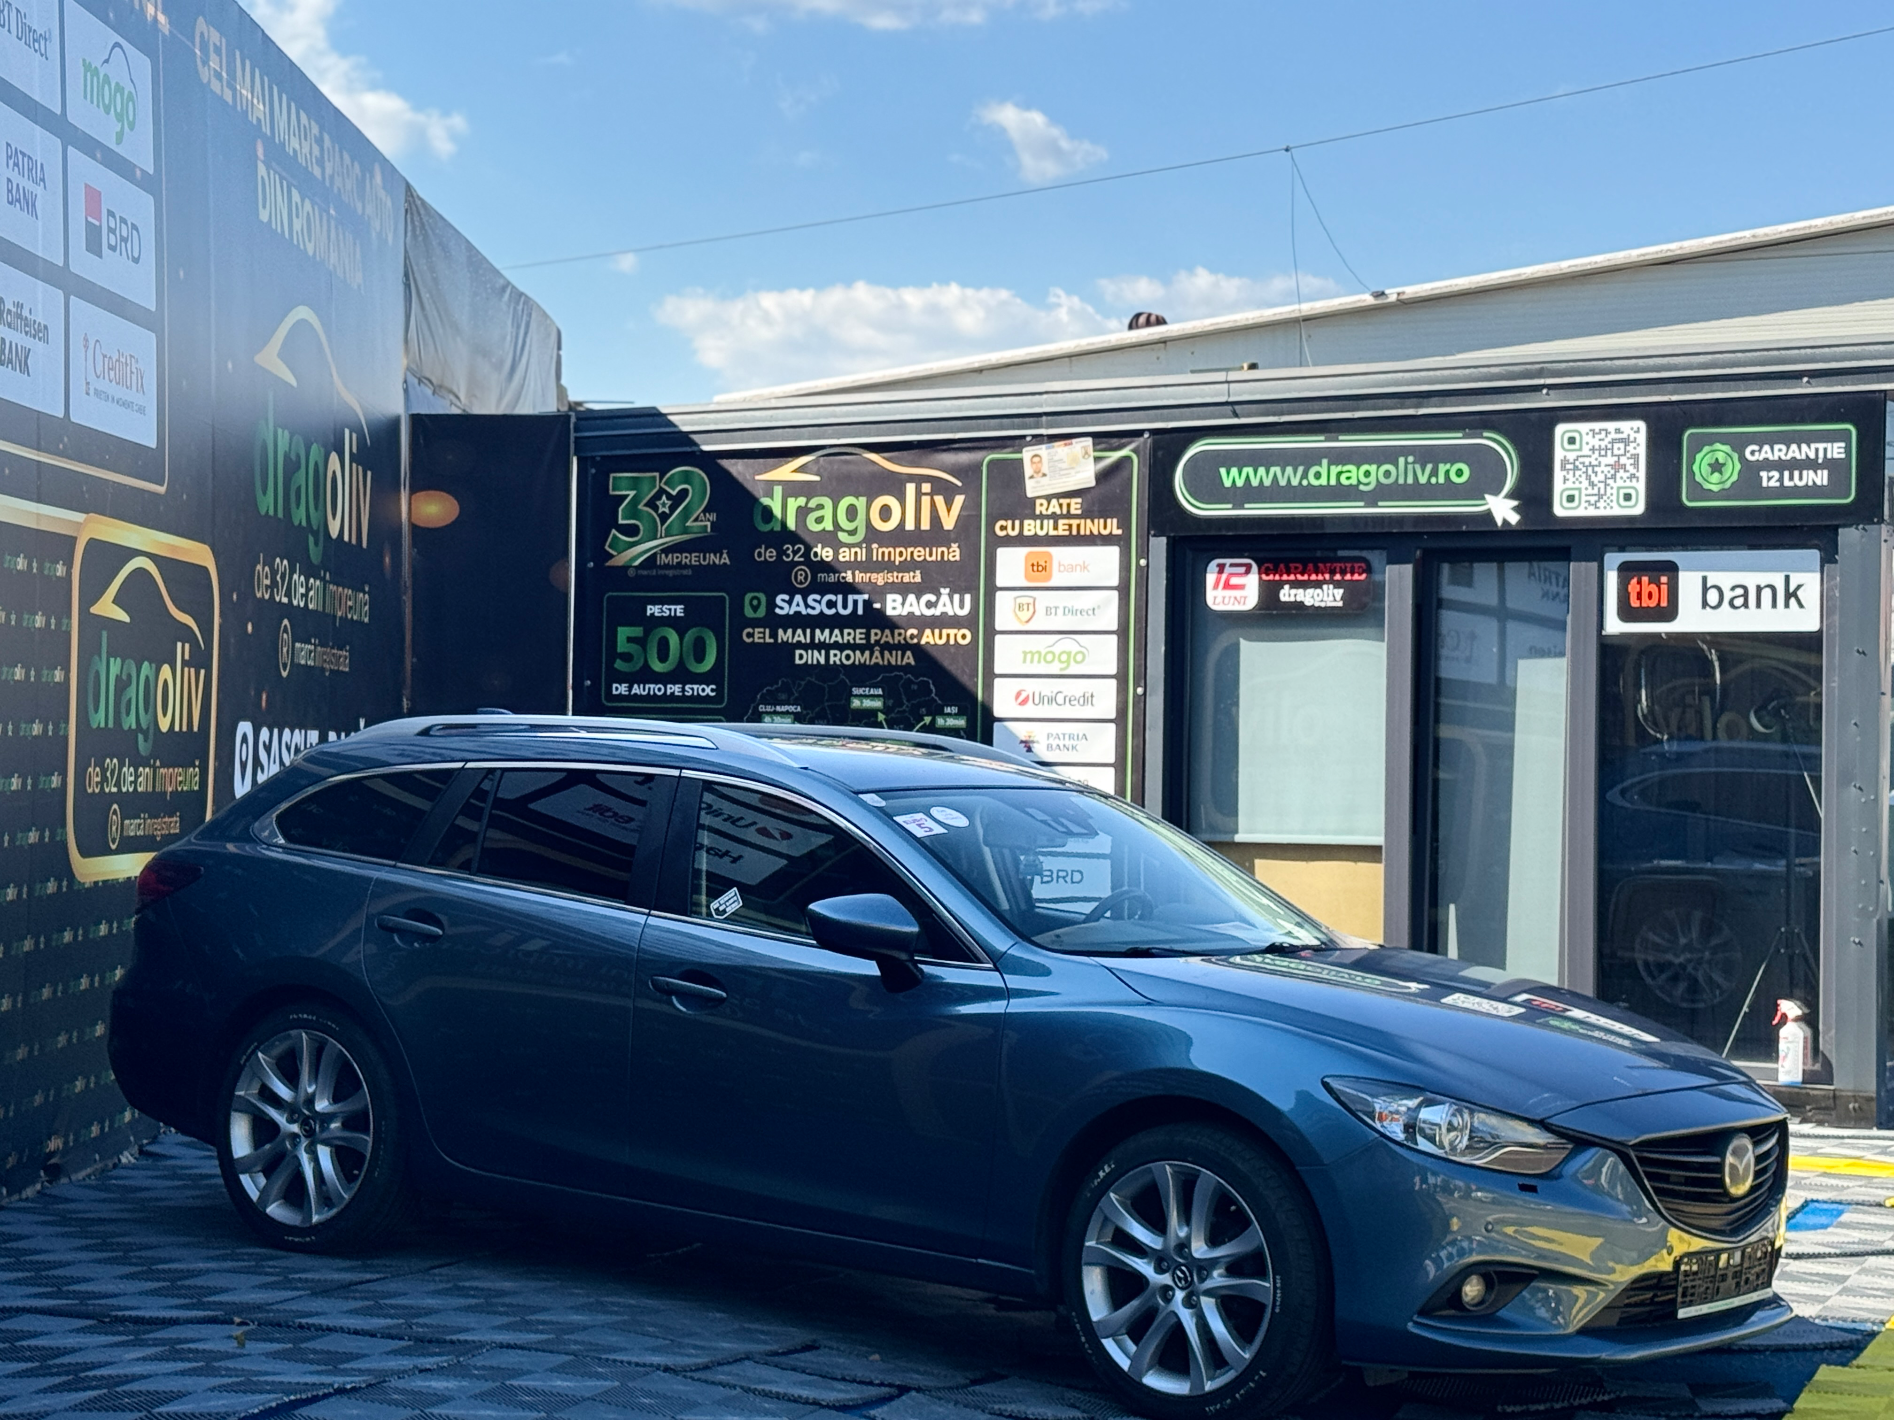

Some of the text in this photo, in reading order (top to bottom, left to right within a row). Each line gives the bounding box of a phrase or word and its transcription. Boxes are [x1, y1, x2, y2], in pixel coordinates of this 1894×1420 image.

[82, 58, 136, 145] mogo
[195, 16, 232, 106] CEL
[235, 48, 270, 136] MAI
[273, 83, 321, 181] MARE
[323, 132, 362, 216] PARC
[6, 141, 47, 191] PATRIA
[6, 176, 38, 221] BANK
[257, 160, 289, 240] DIN
[107, 208, 141, 265] BRD
[0, 295, 49, 345] Raiffeisen
[0, 336, 31, 377] BANK
[93, 338, 145, 395] CreditFix
[1745, 442, 1846, 464] GARANȚIE
[254, 389, 372, 565] dragoliv
[1219, 456, 1471, 491] www.dragoliv.ro
[1759, 470, 1829, 487] 12 LUNI
[605, 466, 710, 556] 32
[753, 482, 966, 544] dragoliv
[1035, 498, 1083, 515] RATE
[994, 518, 1123, 536] CU BULETINUL
[754, 543, 960, 565] de 32 de ani împreună
[1030, 560, 1090, 573] tbi bank
[255, 553, 271, 600] de
[274, 557, 289, 604] 32
[292, 563, 305, 608] de
[308, 570, 323, 612] ani
[817, 570, 853, 583] marcă
[854, 570, 922, 586] înregistrată
[1212, 563, 1253, 591] 12
[1259, 563, 1367, 580] GARANTIE
[774, 594, 870, 615] SASCUT
[885, 588, 971, 616] BACĂU
[1212, 596, 1248, 606] LUNI
[1279, 584, 1344, 606] dragoliv
[1628, 575, 1806, 610] tbi bank
[646, 605, 685, 617] PESTE
[1045, 606, 1059, 617] BT
[742, 628, 972, 645] CEL MAI MARE PARC AUTO
[613, 626, 717, 673] 500
[794, 647, 916, 666] DIN ROMÂNIA
[1021, 650, 1086, 672] mogo
[88, 631, 205, 756] dragoliv
[612, 683, 717, 696] DE AUTO PE STOC
[1032, 691, 1095, 707] UniCredit
[1046, 733, 1088, 742] PATRIA
[1046, 743, 1079, 752] BANK
[86, 757, 200, 800] de 32 de ani împreună
[1040, 869, 1084, 884] BRD
